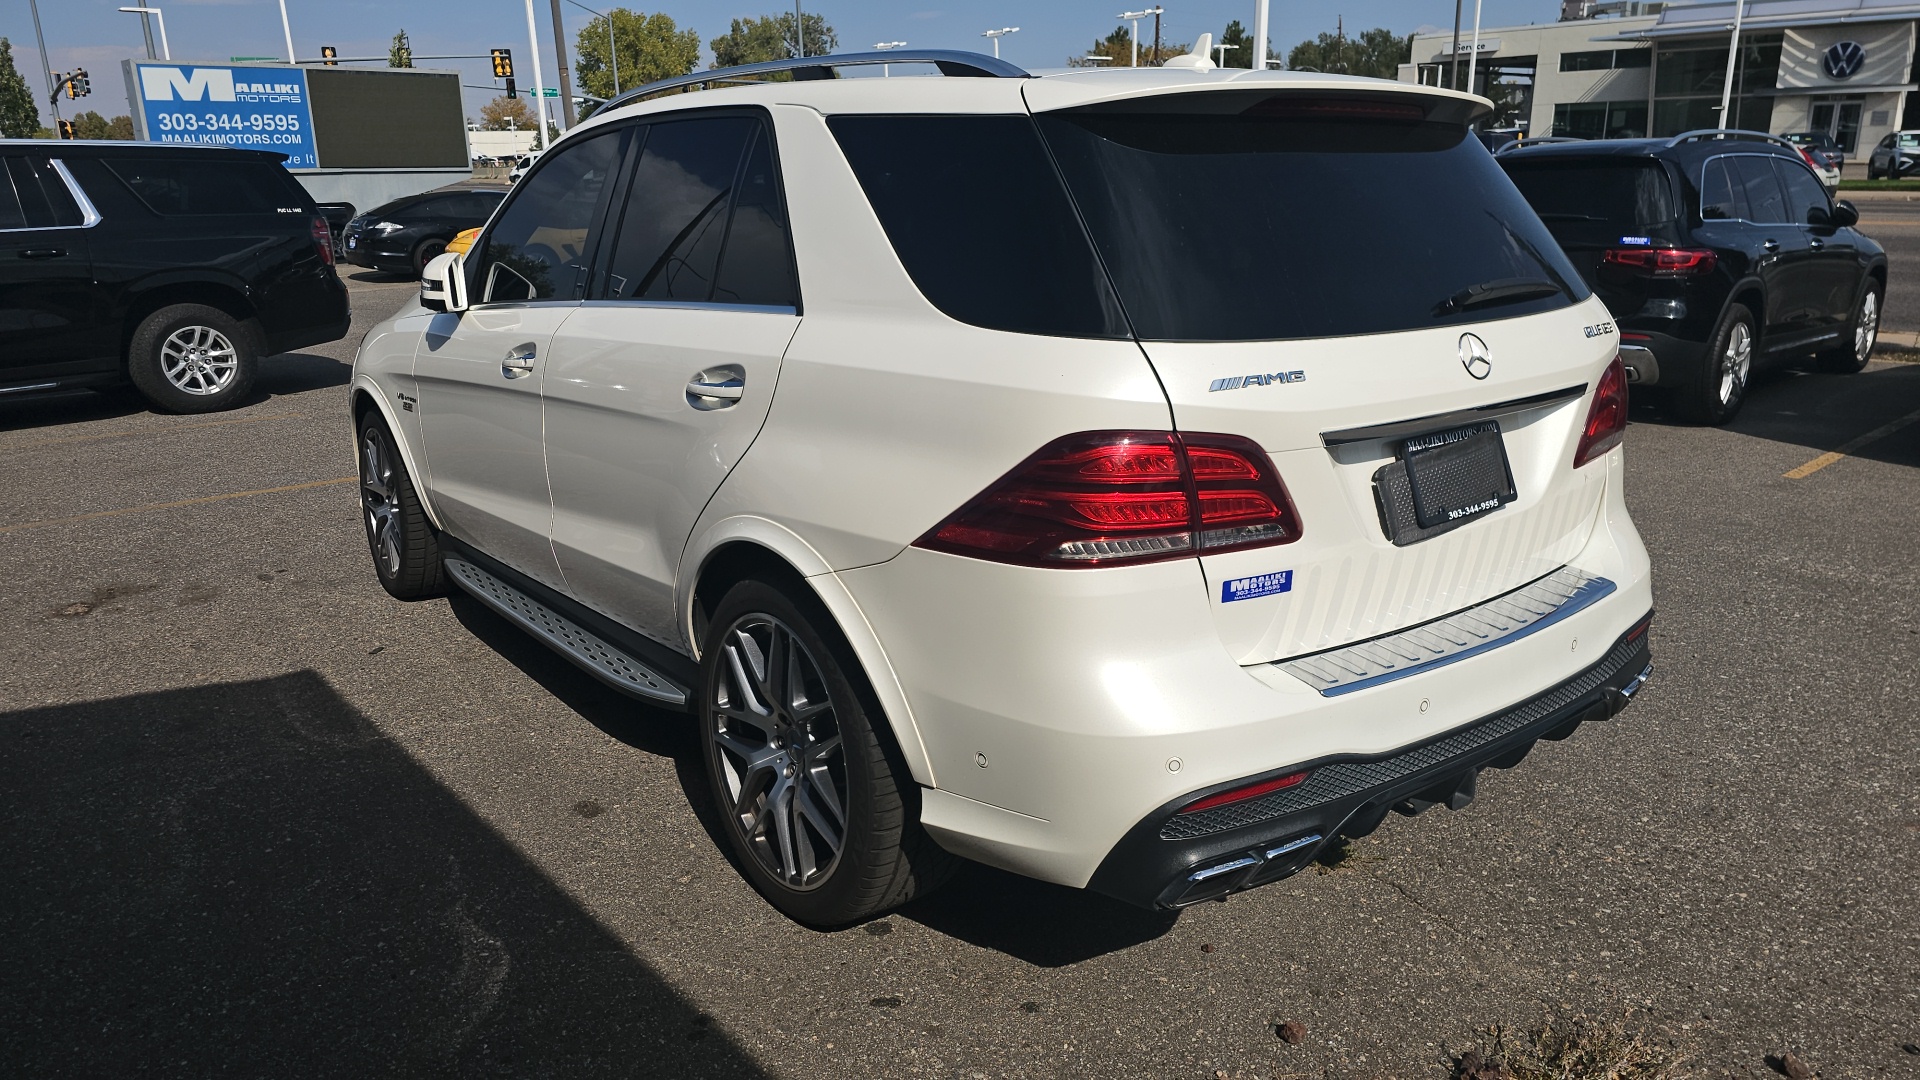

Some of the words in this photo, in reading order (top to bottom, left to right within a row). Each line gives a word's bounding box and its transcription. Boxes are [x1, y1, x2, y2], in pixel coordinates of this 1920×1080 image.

[1457, 43, 1485, 51] Servce
[140, 66, 300, 103] MAALIKI
[236, 94, 301, 103] MOTORS
[158, 113, 300, 131] 303-344-9595
[161, 134, 302, 145] MAALIKIMOTORS.COM
[1448, 499, 1499, 520] 303-344-9595
[1236, 584, 1281, 596] 303-344-9595
